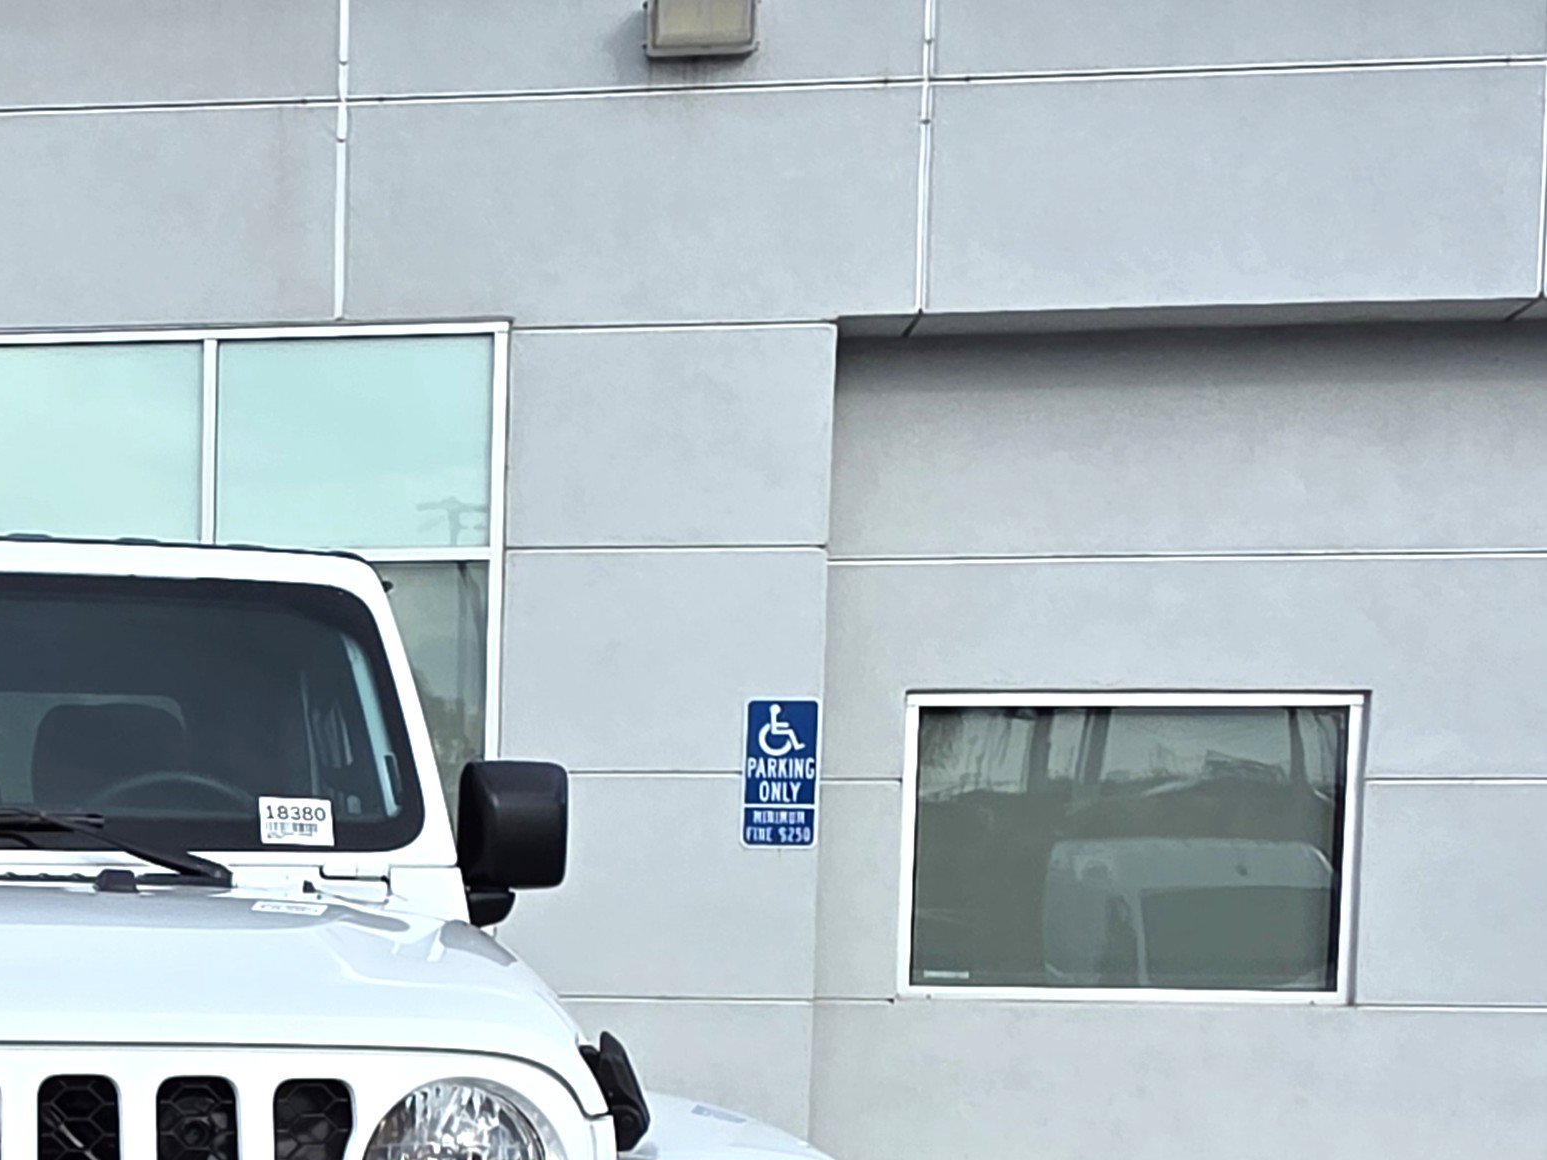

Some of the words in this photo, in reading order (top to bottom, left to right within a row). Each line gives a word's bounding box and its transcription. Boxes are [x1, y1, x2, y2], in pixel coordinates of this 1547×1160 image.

[747, 757, 815, 779] PARKING
[759, 781, 801, 802] ONLY
[266, 805, 326, 821] 18380
[753, 810, 805, 824] MINIMUM
[746, 827, 772, 841] FINE
[778, 827, 811, 842] $250
